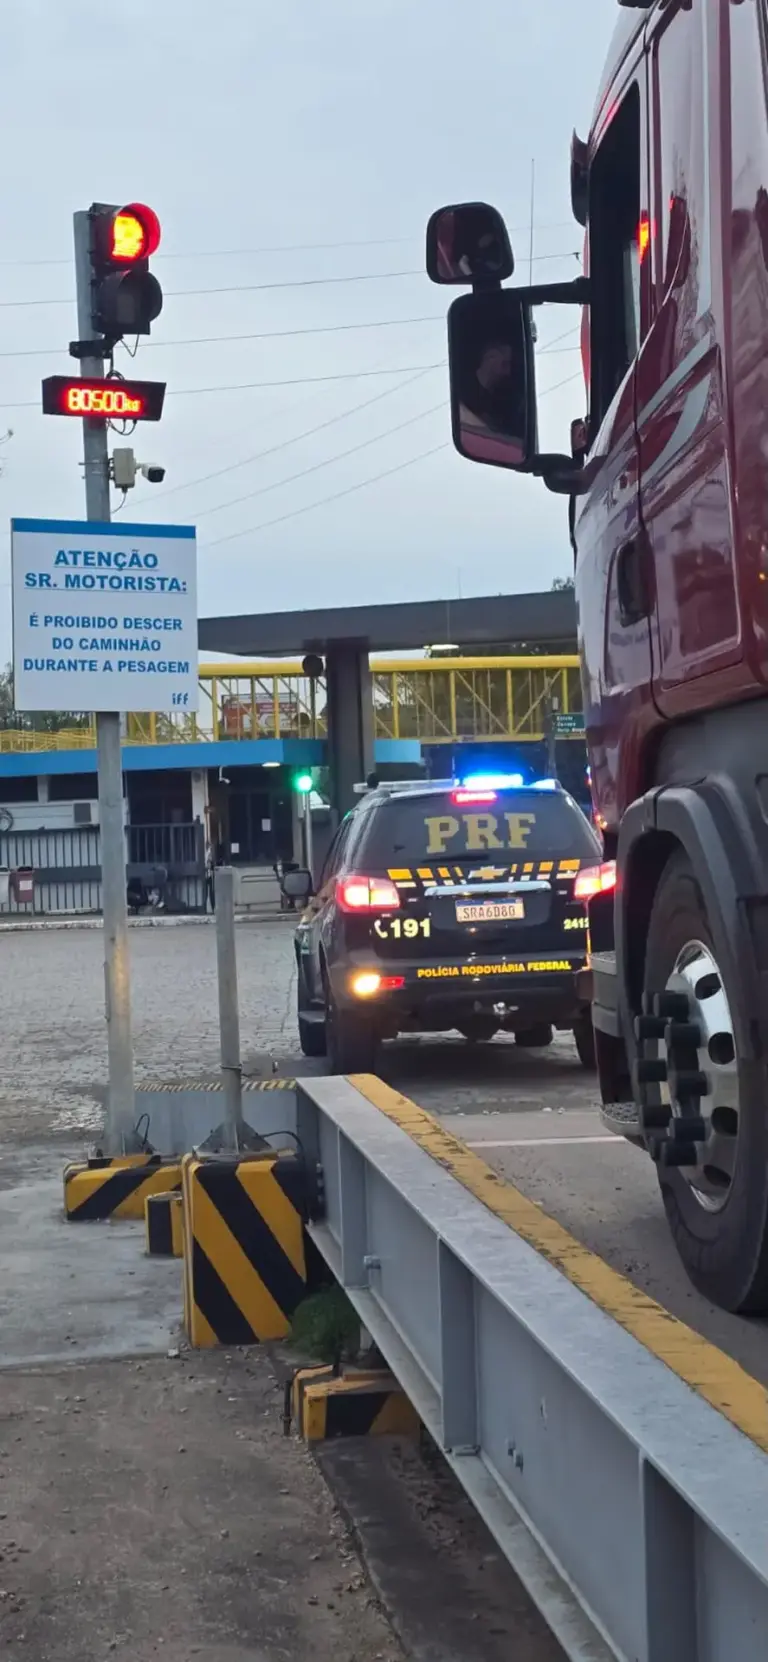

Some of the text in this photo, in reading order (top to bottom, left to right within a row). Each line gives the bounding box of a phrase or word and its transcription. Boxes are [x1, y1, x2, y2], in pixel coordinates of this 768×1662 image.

[54, 549, 158, 571] ATENÇÃO
[25, 573, 187, 591] SR. MOTORISTA:
[29, 612, 182, 631] É PROIBIDO DESCER
[52, 637, 161, 651] DO CAMINHÃO
[24, 658, 189, 673] DURANTE A PESAGEM
[172, 693, 188, 705] iff
[424, 812, 536, 854] PRF
[390, 918, 430, 938] 191
[418, 961, 571, 977] POLÍCIA RODOVIÁRIA FEDERAL
